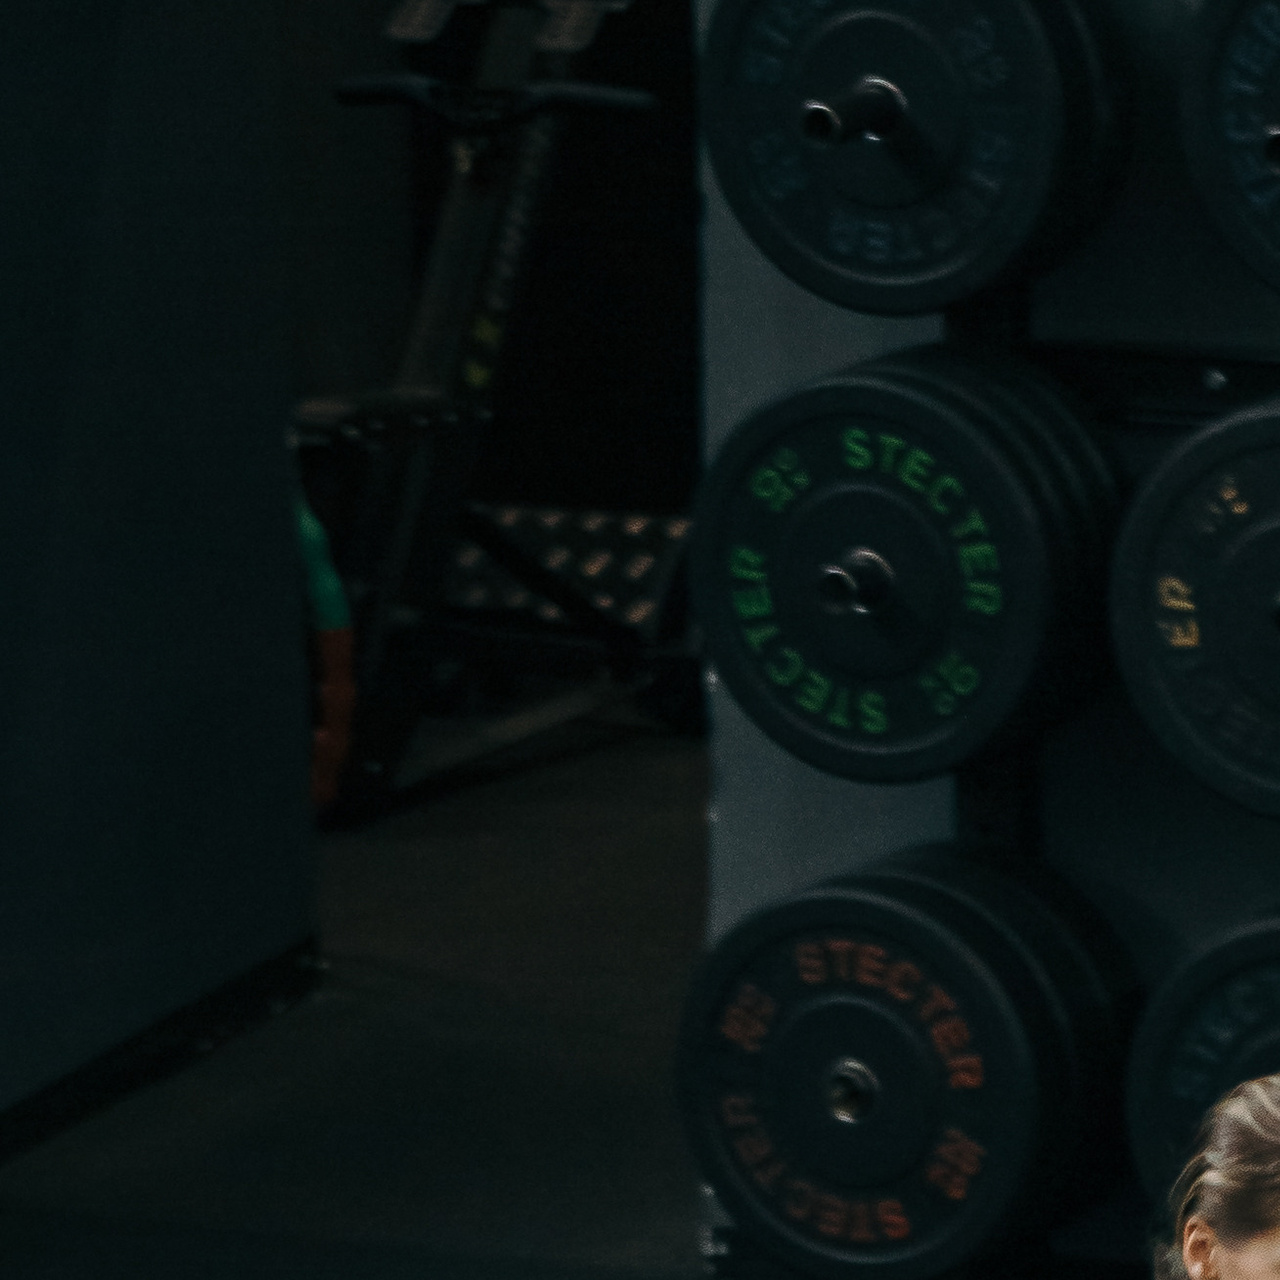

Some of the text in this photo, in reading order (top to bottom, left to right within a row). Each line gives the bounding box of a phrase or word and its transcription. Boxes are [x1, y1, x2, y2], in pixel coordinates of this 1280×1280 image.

[842, 427, 1003, 617] STECTER
[729, 545, 889, 735] STECTER
[794, 938, 985, 1090] STECTER
